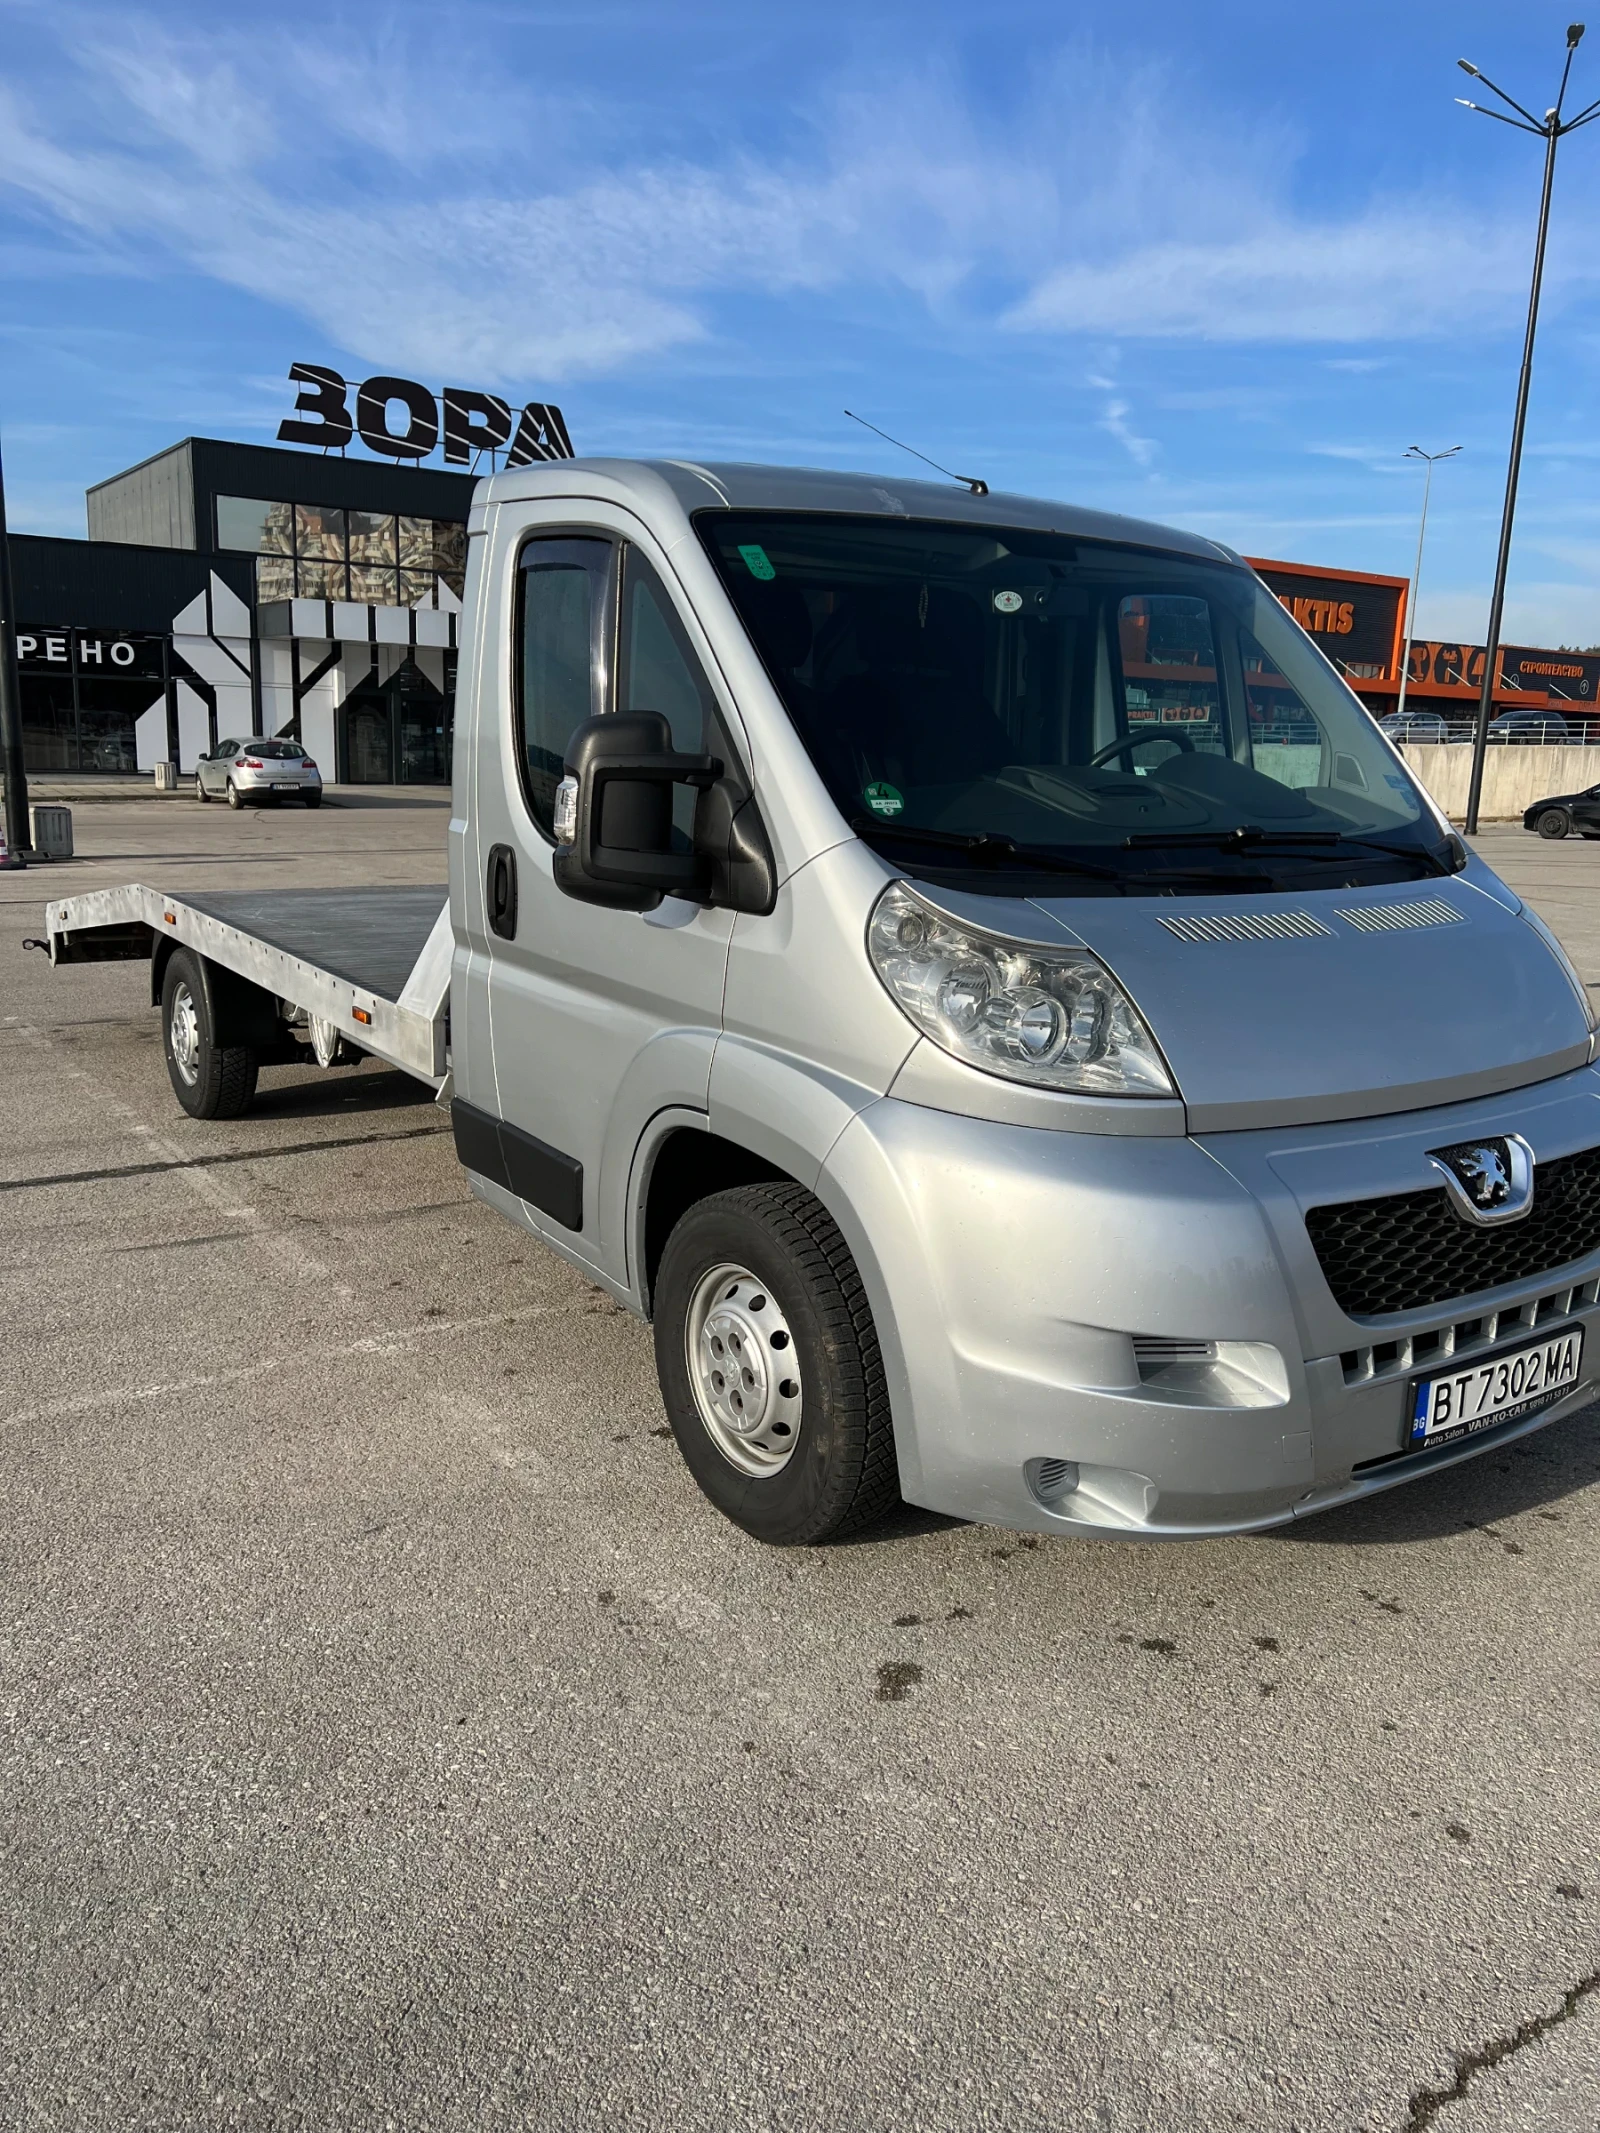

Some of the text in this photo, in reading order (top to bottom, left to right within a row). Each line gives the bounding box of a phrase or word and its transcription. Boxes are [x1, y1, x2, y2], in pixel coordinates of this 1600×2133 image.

[276, 362, 576, 470] ЗОРА
[16, 635, 135, 666] РЕНО
[1520, 660, 1584, 678] СТРОИТЕЛСТВО
[877, 783, 890, 799] 4
[1412, 1416, 1426, 1432] BG
[1423, 1435, 1444, 1447] Auto
[1444, 1428, 1465, 1441] Salon
[1468, 1402, 1527, 1432] VAN-KO-CAR
